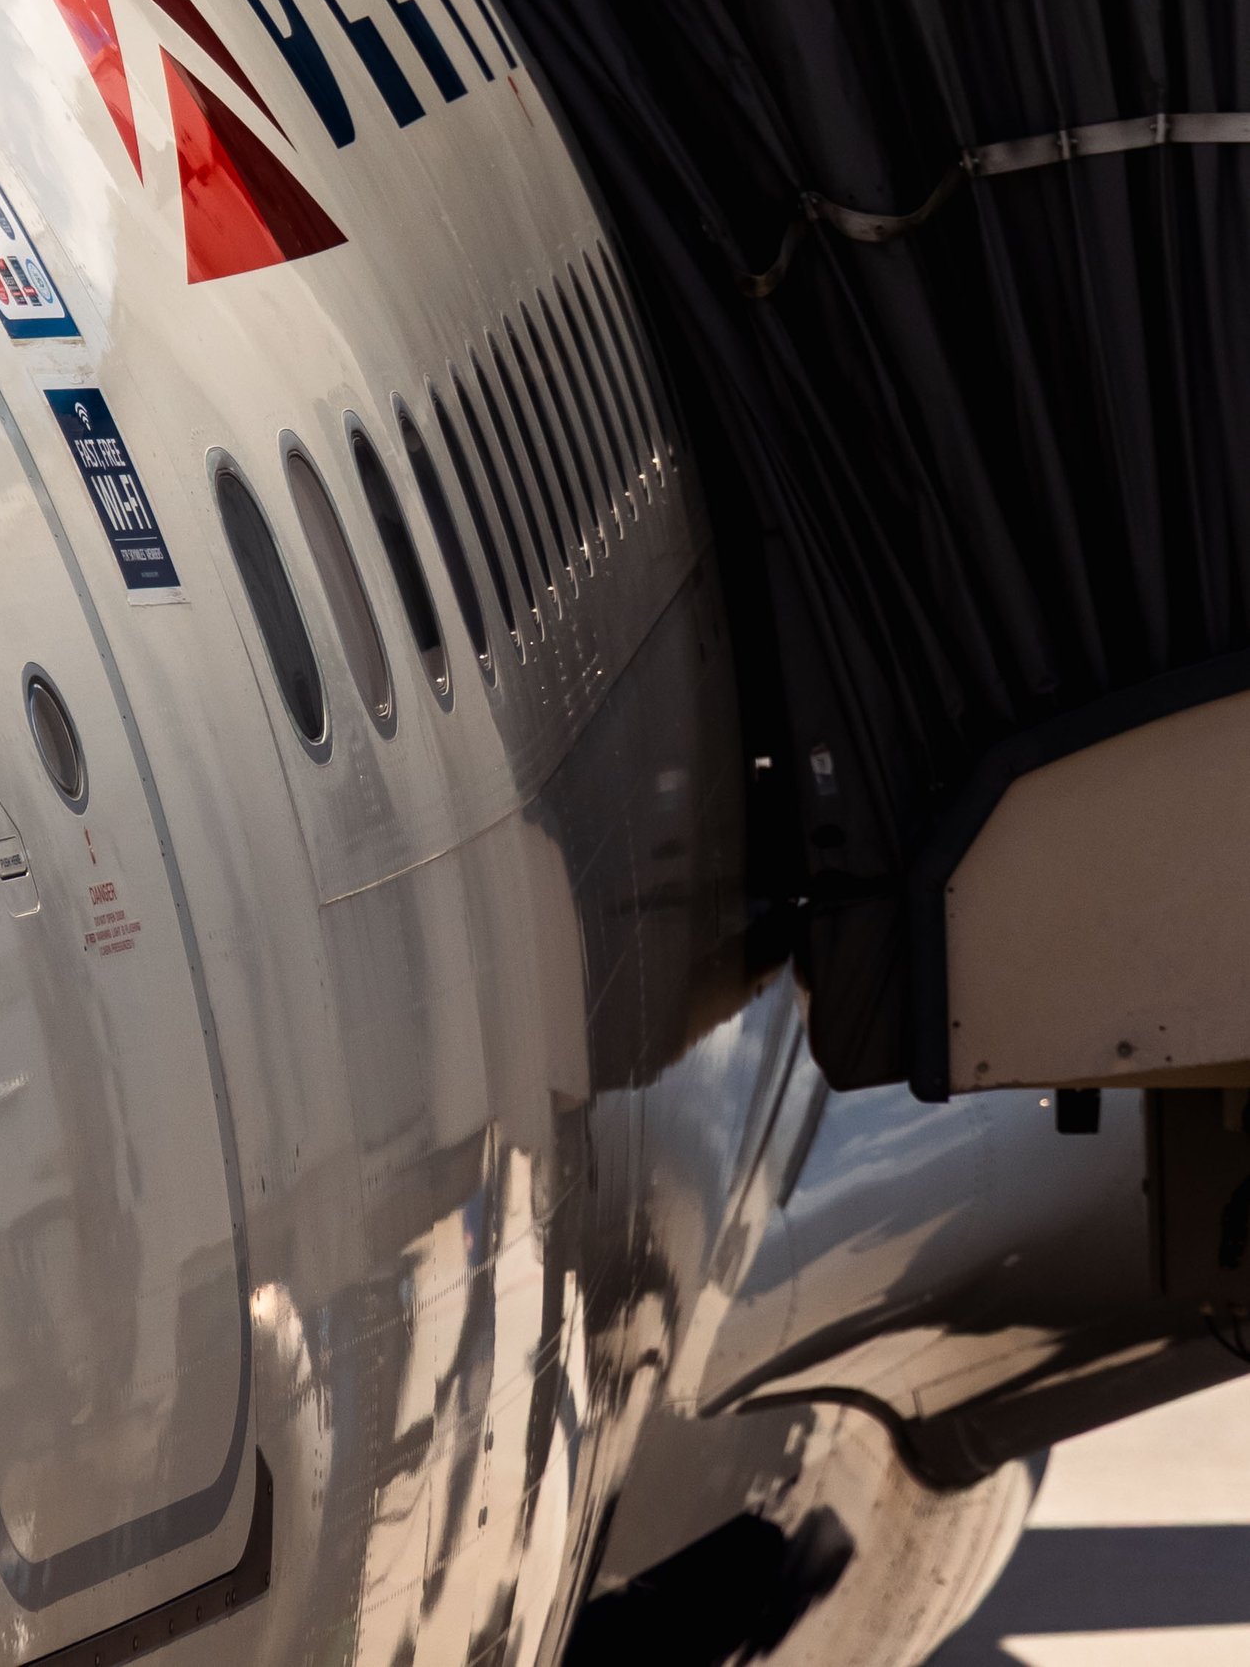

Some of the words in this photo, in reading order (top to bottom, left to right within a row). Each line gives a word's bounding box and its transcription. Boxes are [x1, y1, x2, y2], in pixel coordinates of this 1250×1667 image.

[74, 439, 106, 470] FAST,
[97, 438, 126, 467] FREE
[91, 474, 152, 531] WI-FI
[89, 882, 117, 905] DANGER
